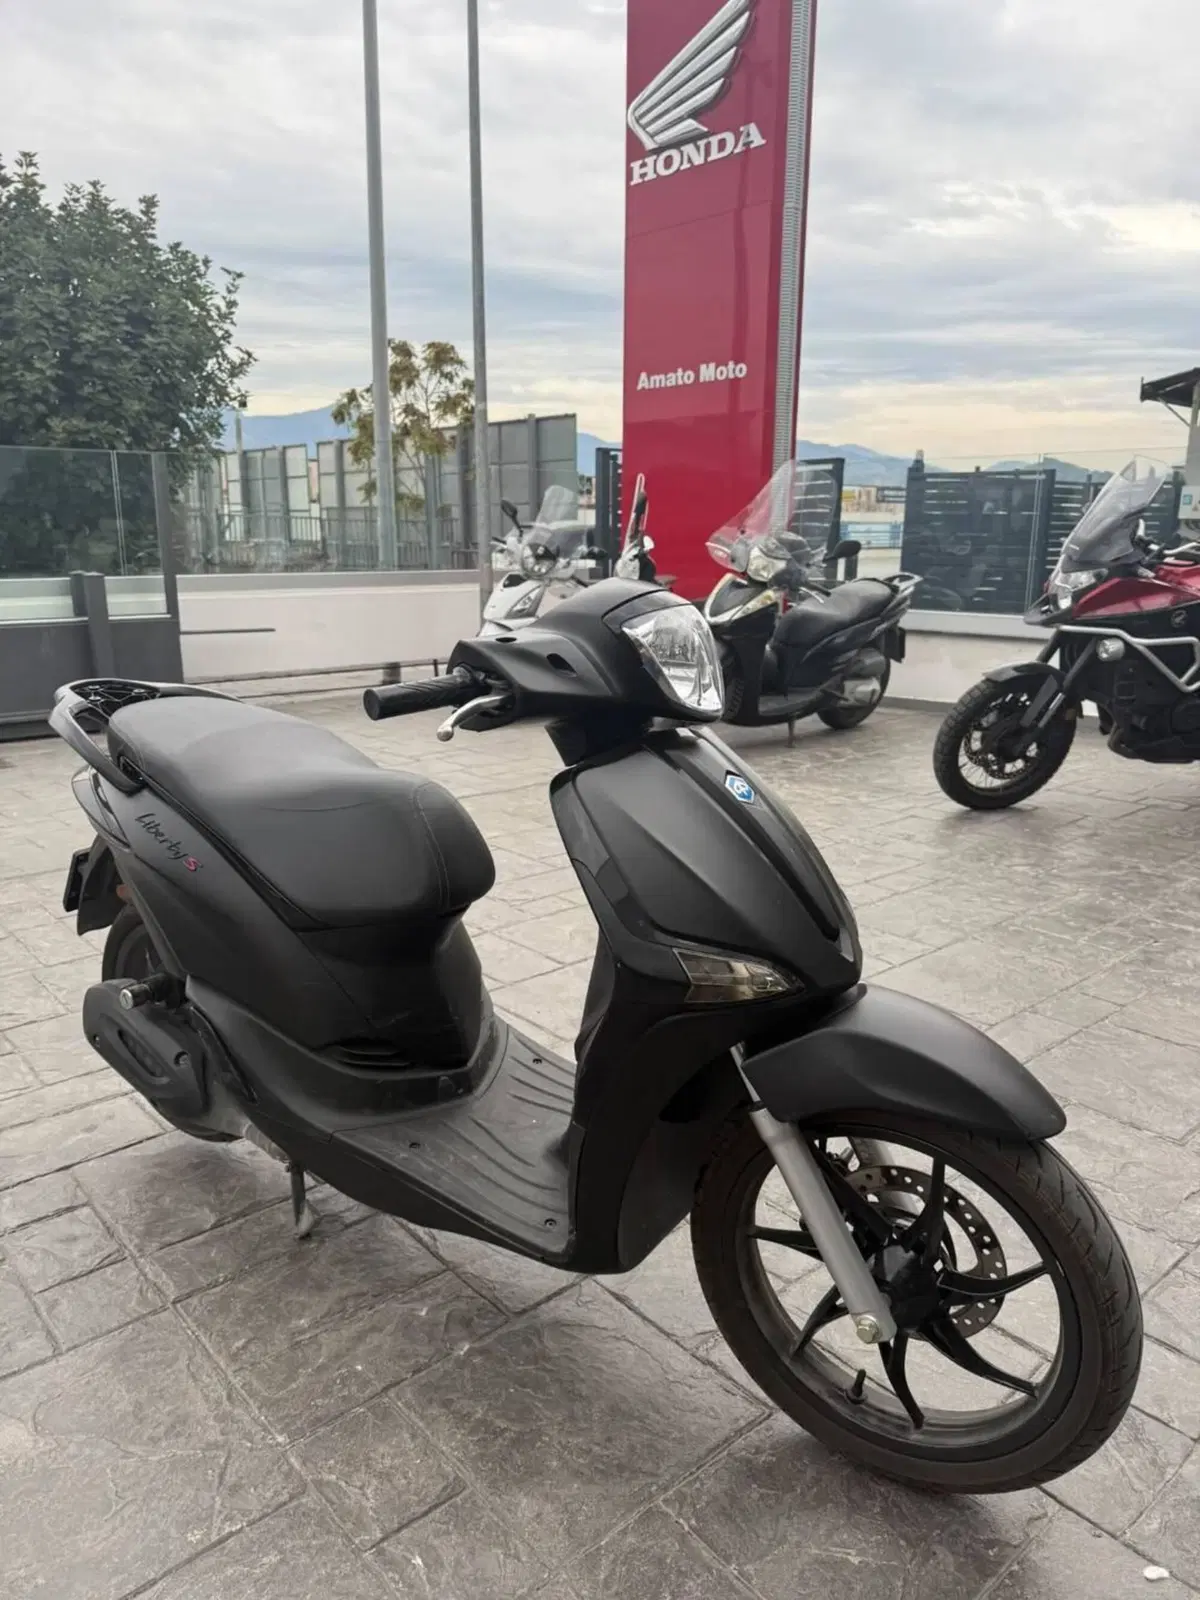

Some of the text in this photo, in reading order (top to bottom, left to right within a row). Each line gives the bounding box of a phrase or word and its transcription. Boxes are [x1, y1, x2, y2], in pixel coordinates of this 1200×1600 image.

[630, 122, 767, 186] HONDA
[636, 360, 748, 391] Amato Moto
[134, 813, 204, 873] Liberty S
